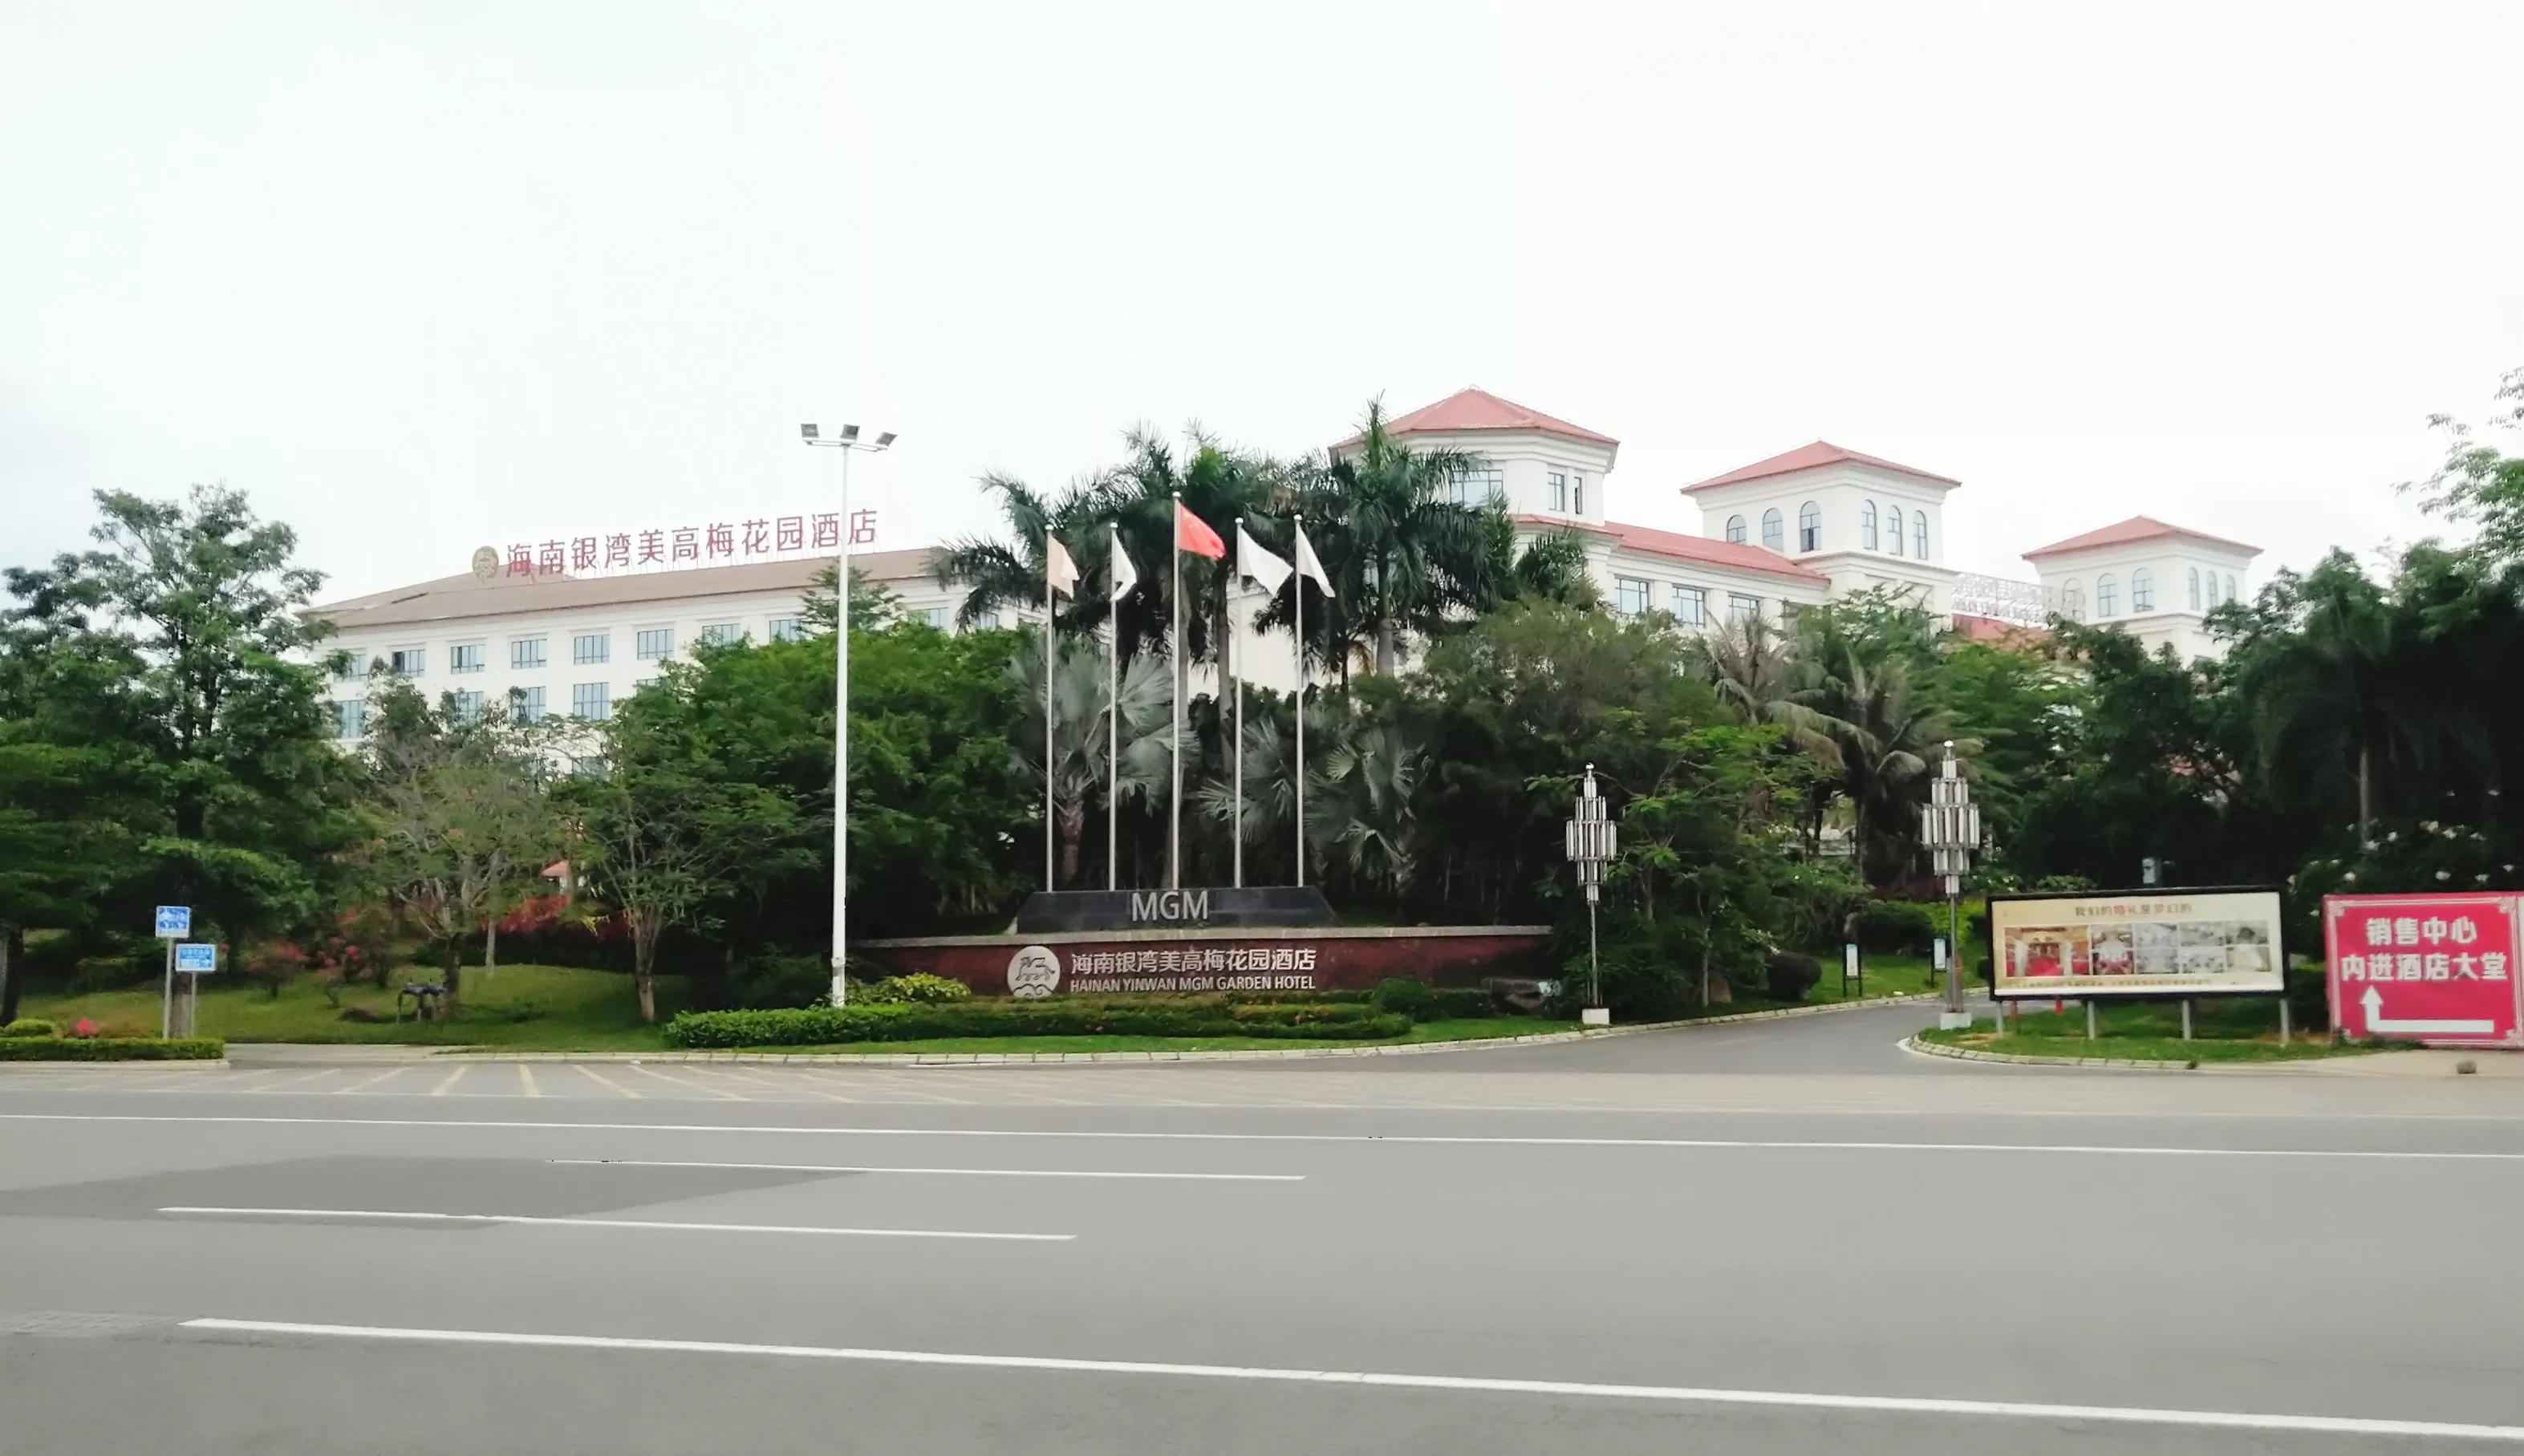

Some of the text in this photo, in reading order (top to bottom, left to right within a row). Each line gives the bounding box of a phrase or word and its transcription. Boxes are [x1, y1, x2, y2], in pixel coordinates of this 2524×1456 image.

[506, 509, 878, 578] 海南银湾美高梅花园酒店
[1131, 891, 1208, 922] MGM
[2366, 916, 2478, 946] 销售中心
[1070, 948, 1317, 975] 海南银湾美高梅花园酒店
[2340, 952, 2508, 981] 内进酒店大堂
[1070, 975, 1317, 992] HAINAN YINWAN MGM GARDEN HOTEL
